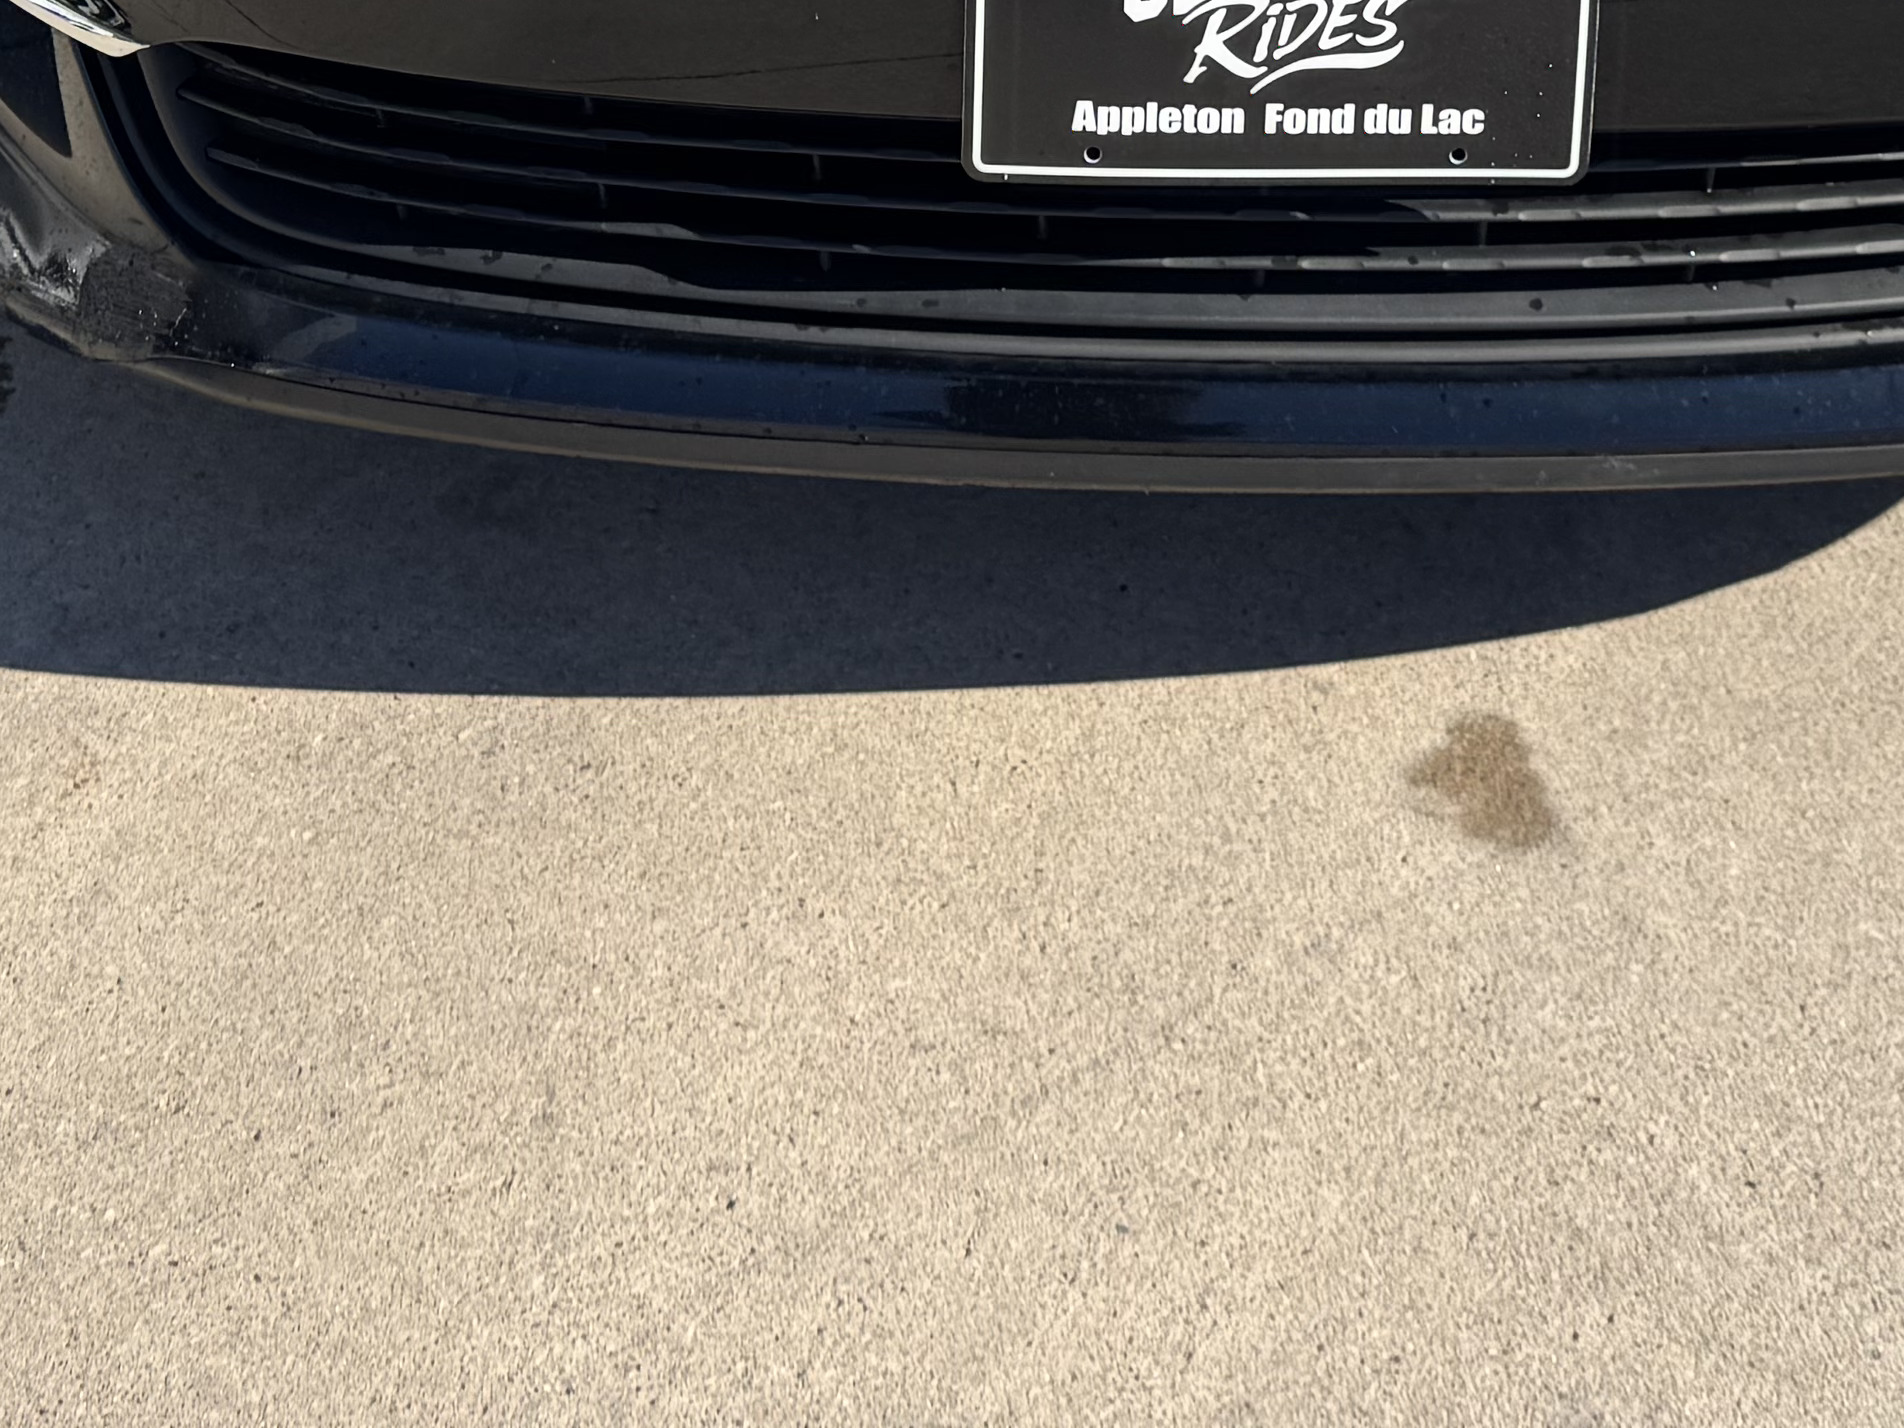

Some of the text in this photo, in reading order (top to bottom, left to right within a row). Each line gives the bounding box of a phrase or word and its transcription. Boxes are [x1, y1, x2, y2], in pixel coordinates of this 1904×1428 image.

[1071, 99, 1486, 136] Appleton Fond du Lac
